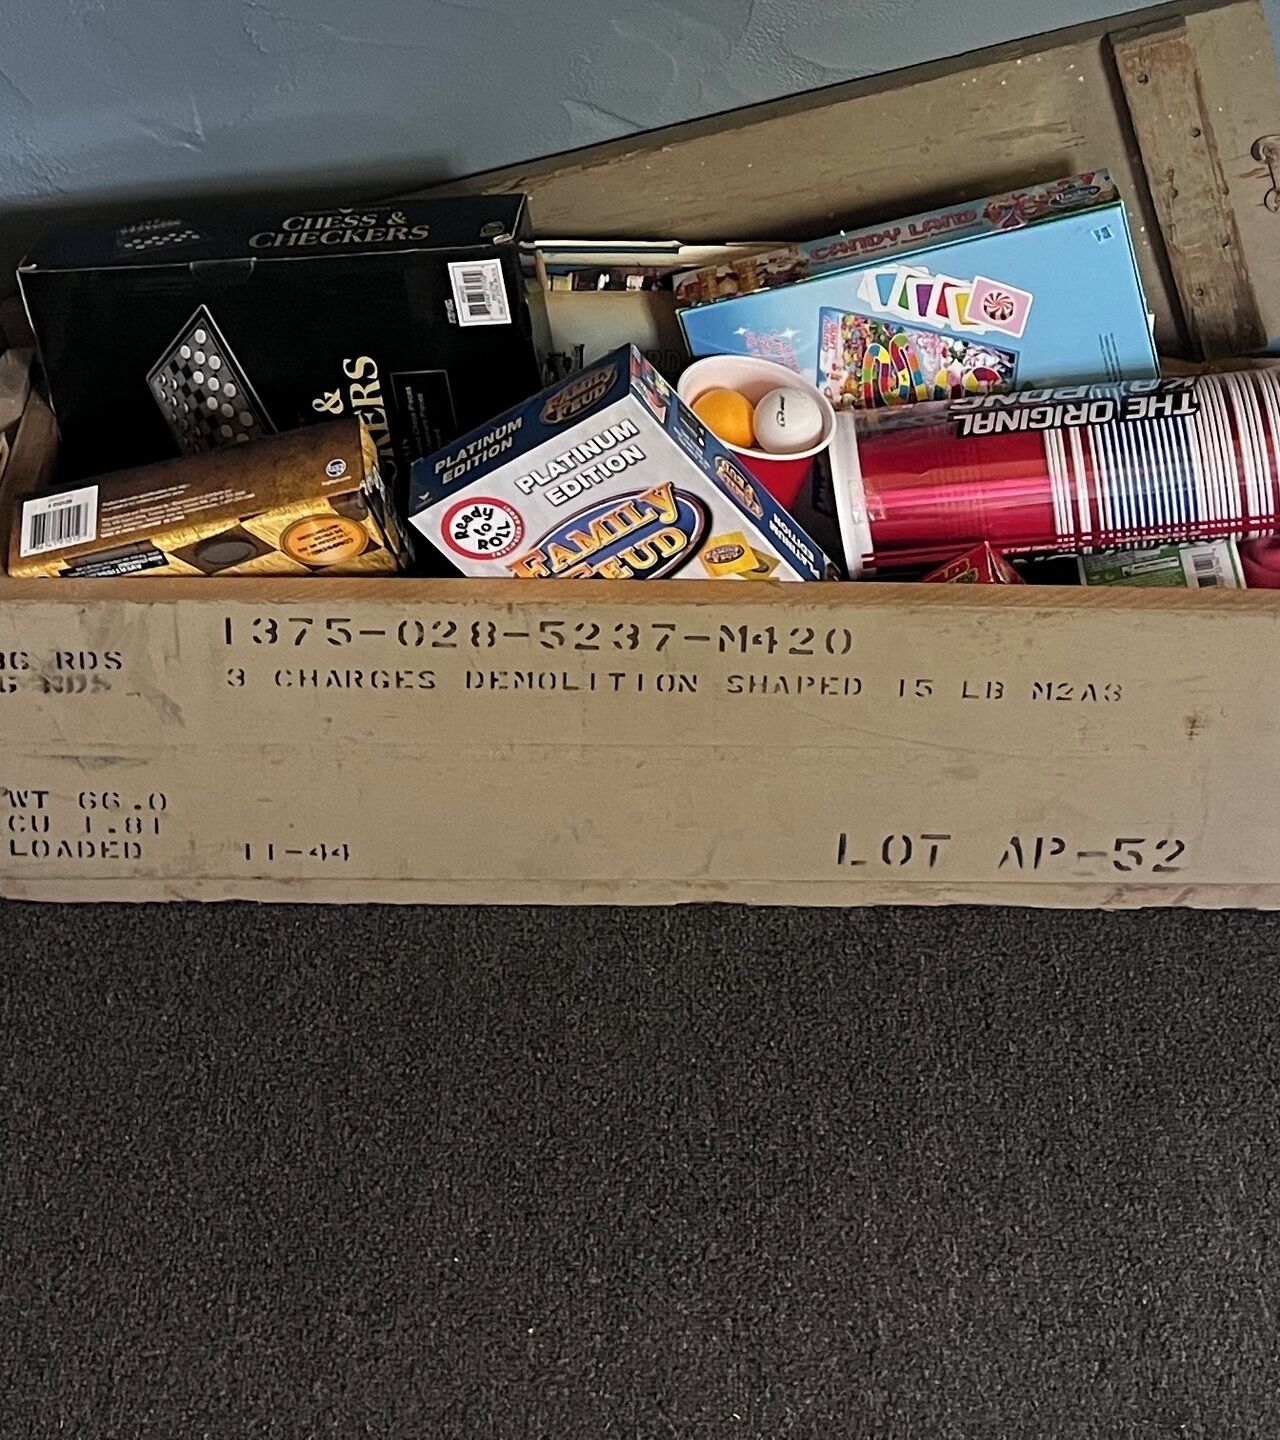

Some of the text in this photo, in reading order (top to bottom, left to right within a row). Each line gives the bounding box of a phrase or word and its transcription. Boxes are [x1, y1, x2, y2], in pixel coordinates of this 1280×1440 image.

[247, 224, 430, 248] CHECKERS
[282, 211, 408, 231] CHESS &
[809, 210, 978, 261] CANDY LAND
[311, 387, 345, 414] &
[953, 393, 1198, 436] THE ORIGINAL
[434, 417, 523, 474] PLATINUM
[442, 436, 513, 484] EDITION
[515, 418, 640, 495] PLATINUM
[544, 444, 646, 507] EDITION
[477, 521, 511, 550] ROLL
[505, 481, 679, 579] FAMILY
[223, 616, 852, 655] 1375-028-5237-M420
[56, 651, 122, 670] RDS
[226, 669, 246, 689] 3
[275, 669, 437, 690] CHARGES
[465, 670, 698, 693] DEMOLITION
[726, 674, 862, 697] SHAPED
[898, 678, 934, 698] 15
[961, 680, 1005, 699] LB
[7, 790, 167, 811] WT 66.0
[7, 815, 160, 835] CU 1.81
[9, 839, 352, 861] LOADED 11-44
[836, 832, 1186, 873] LOT AP-52
